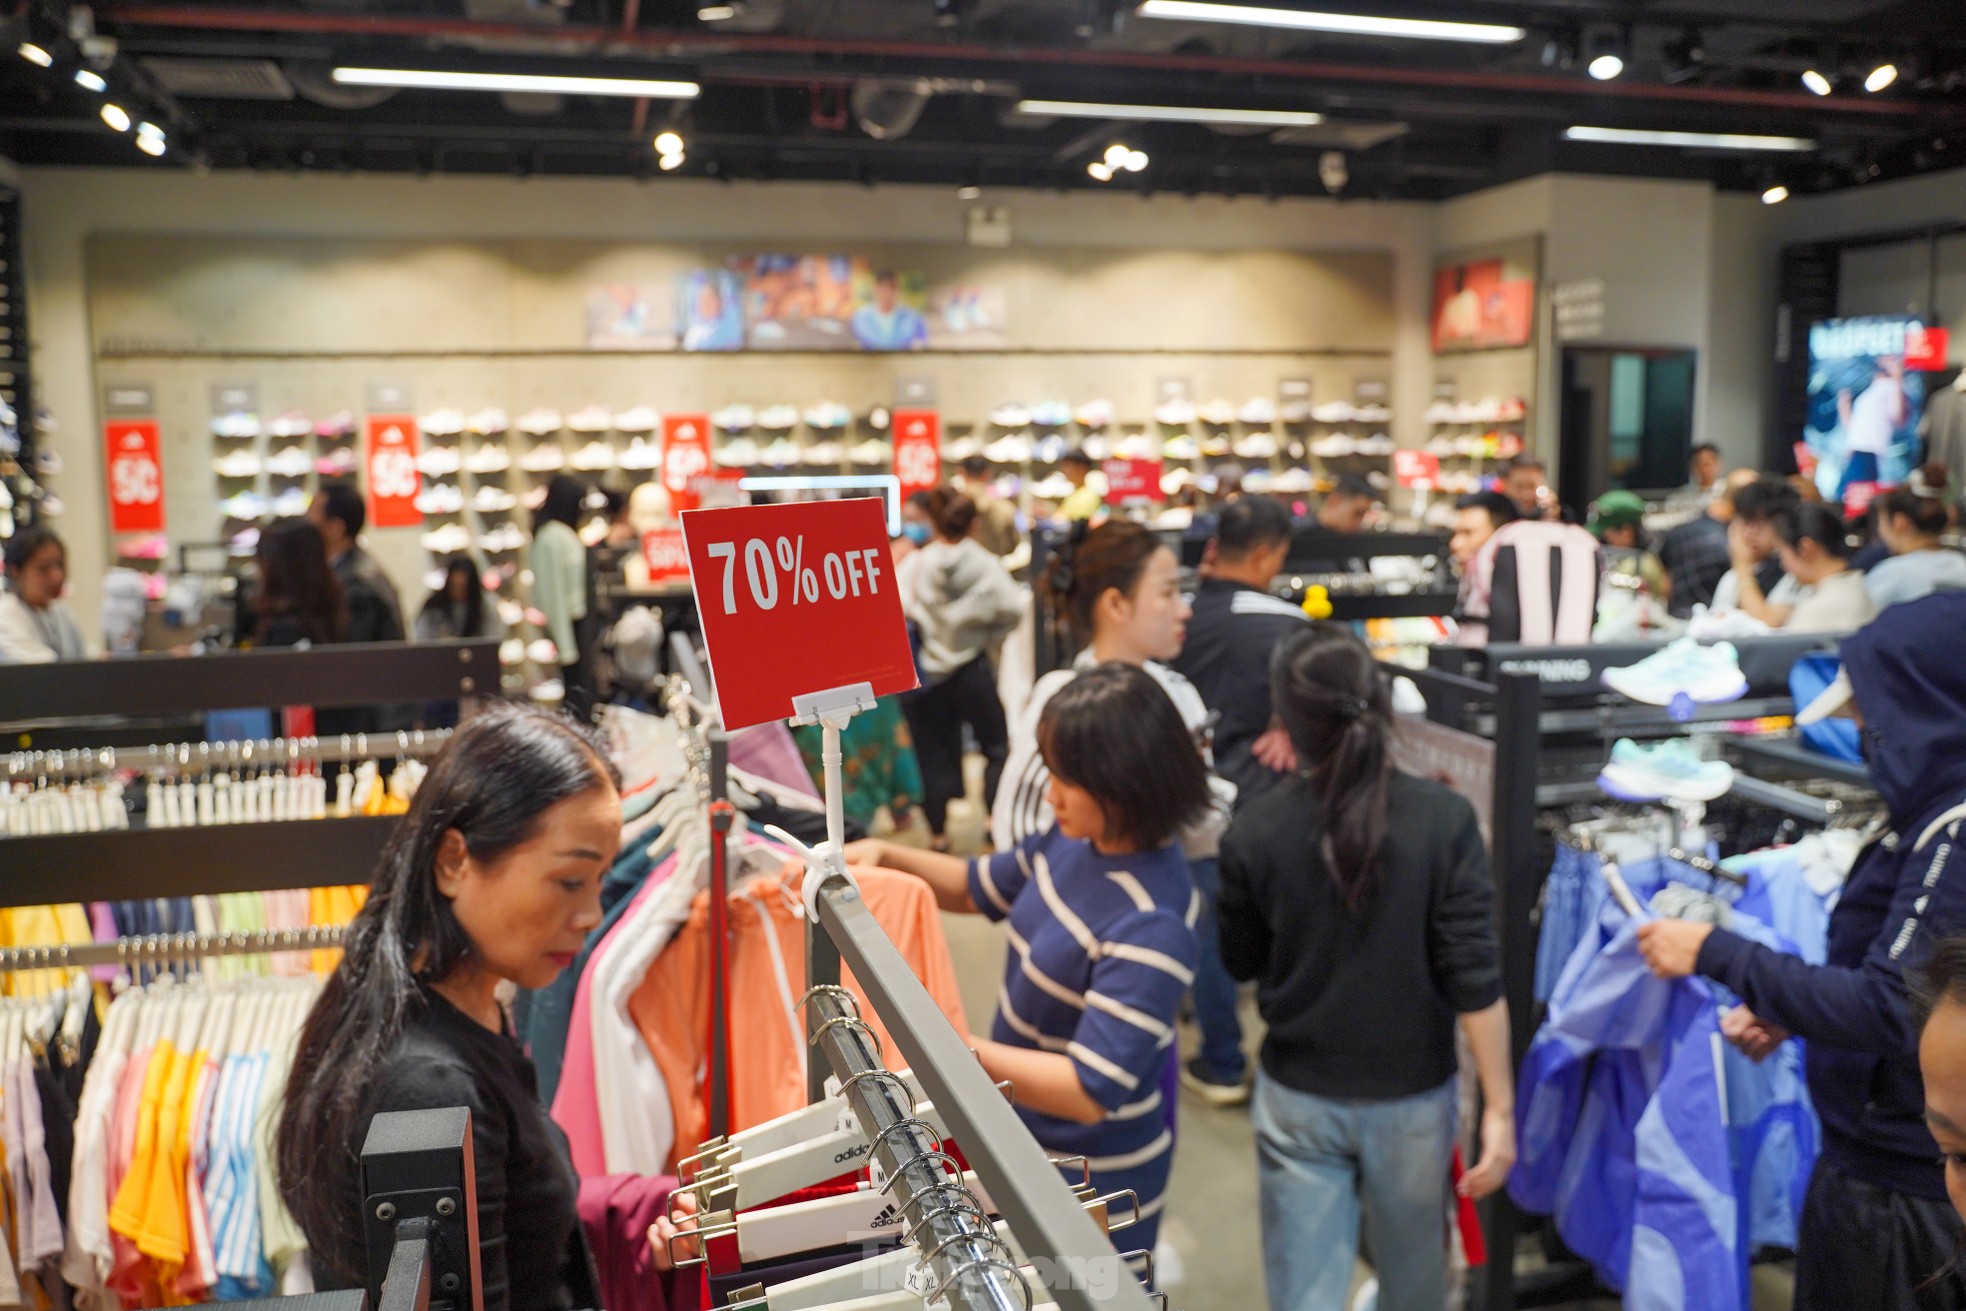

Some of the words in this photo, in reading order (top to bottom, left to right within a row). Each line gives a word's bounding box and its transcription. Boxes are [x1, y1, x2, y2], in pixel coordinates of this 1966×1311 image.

[707, 534, 819, 615] 70%
[823, 548, 881, 600] OFF
[834, 1144, 870, 1164] adida
[877, 1171, 886, 1183] M
[907, 1272, 919, 1291] XL
[924, 1275, 936, 1292] XL
